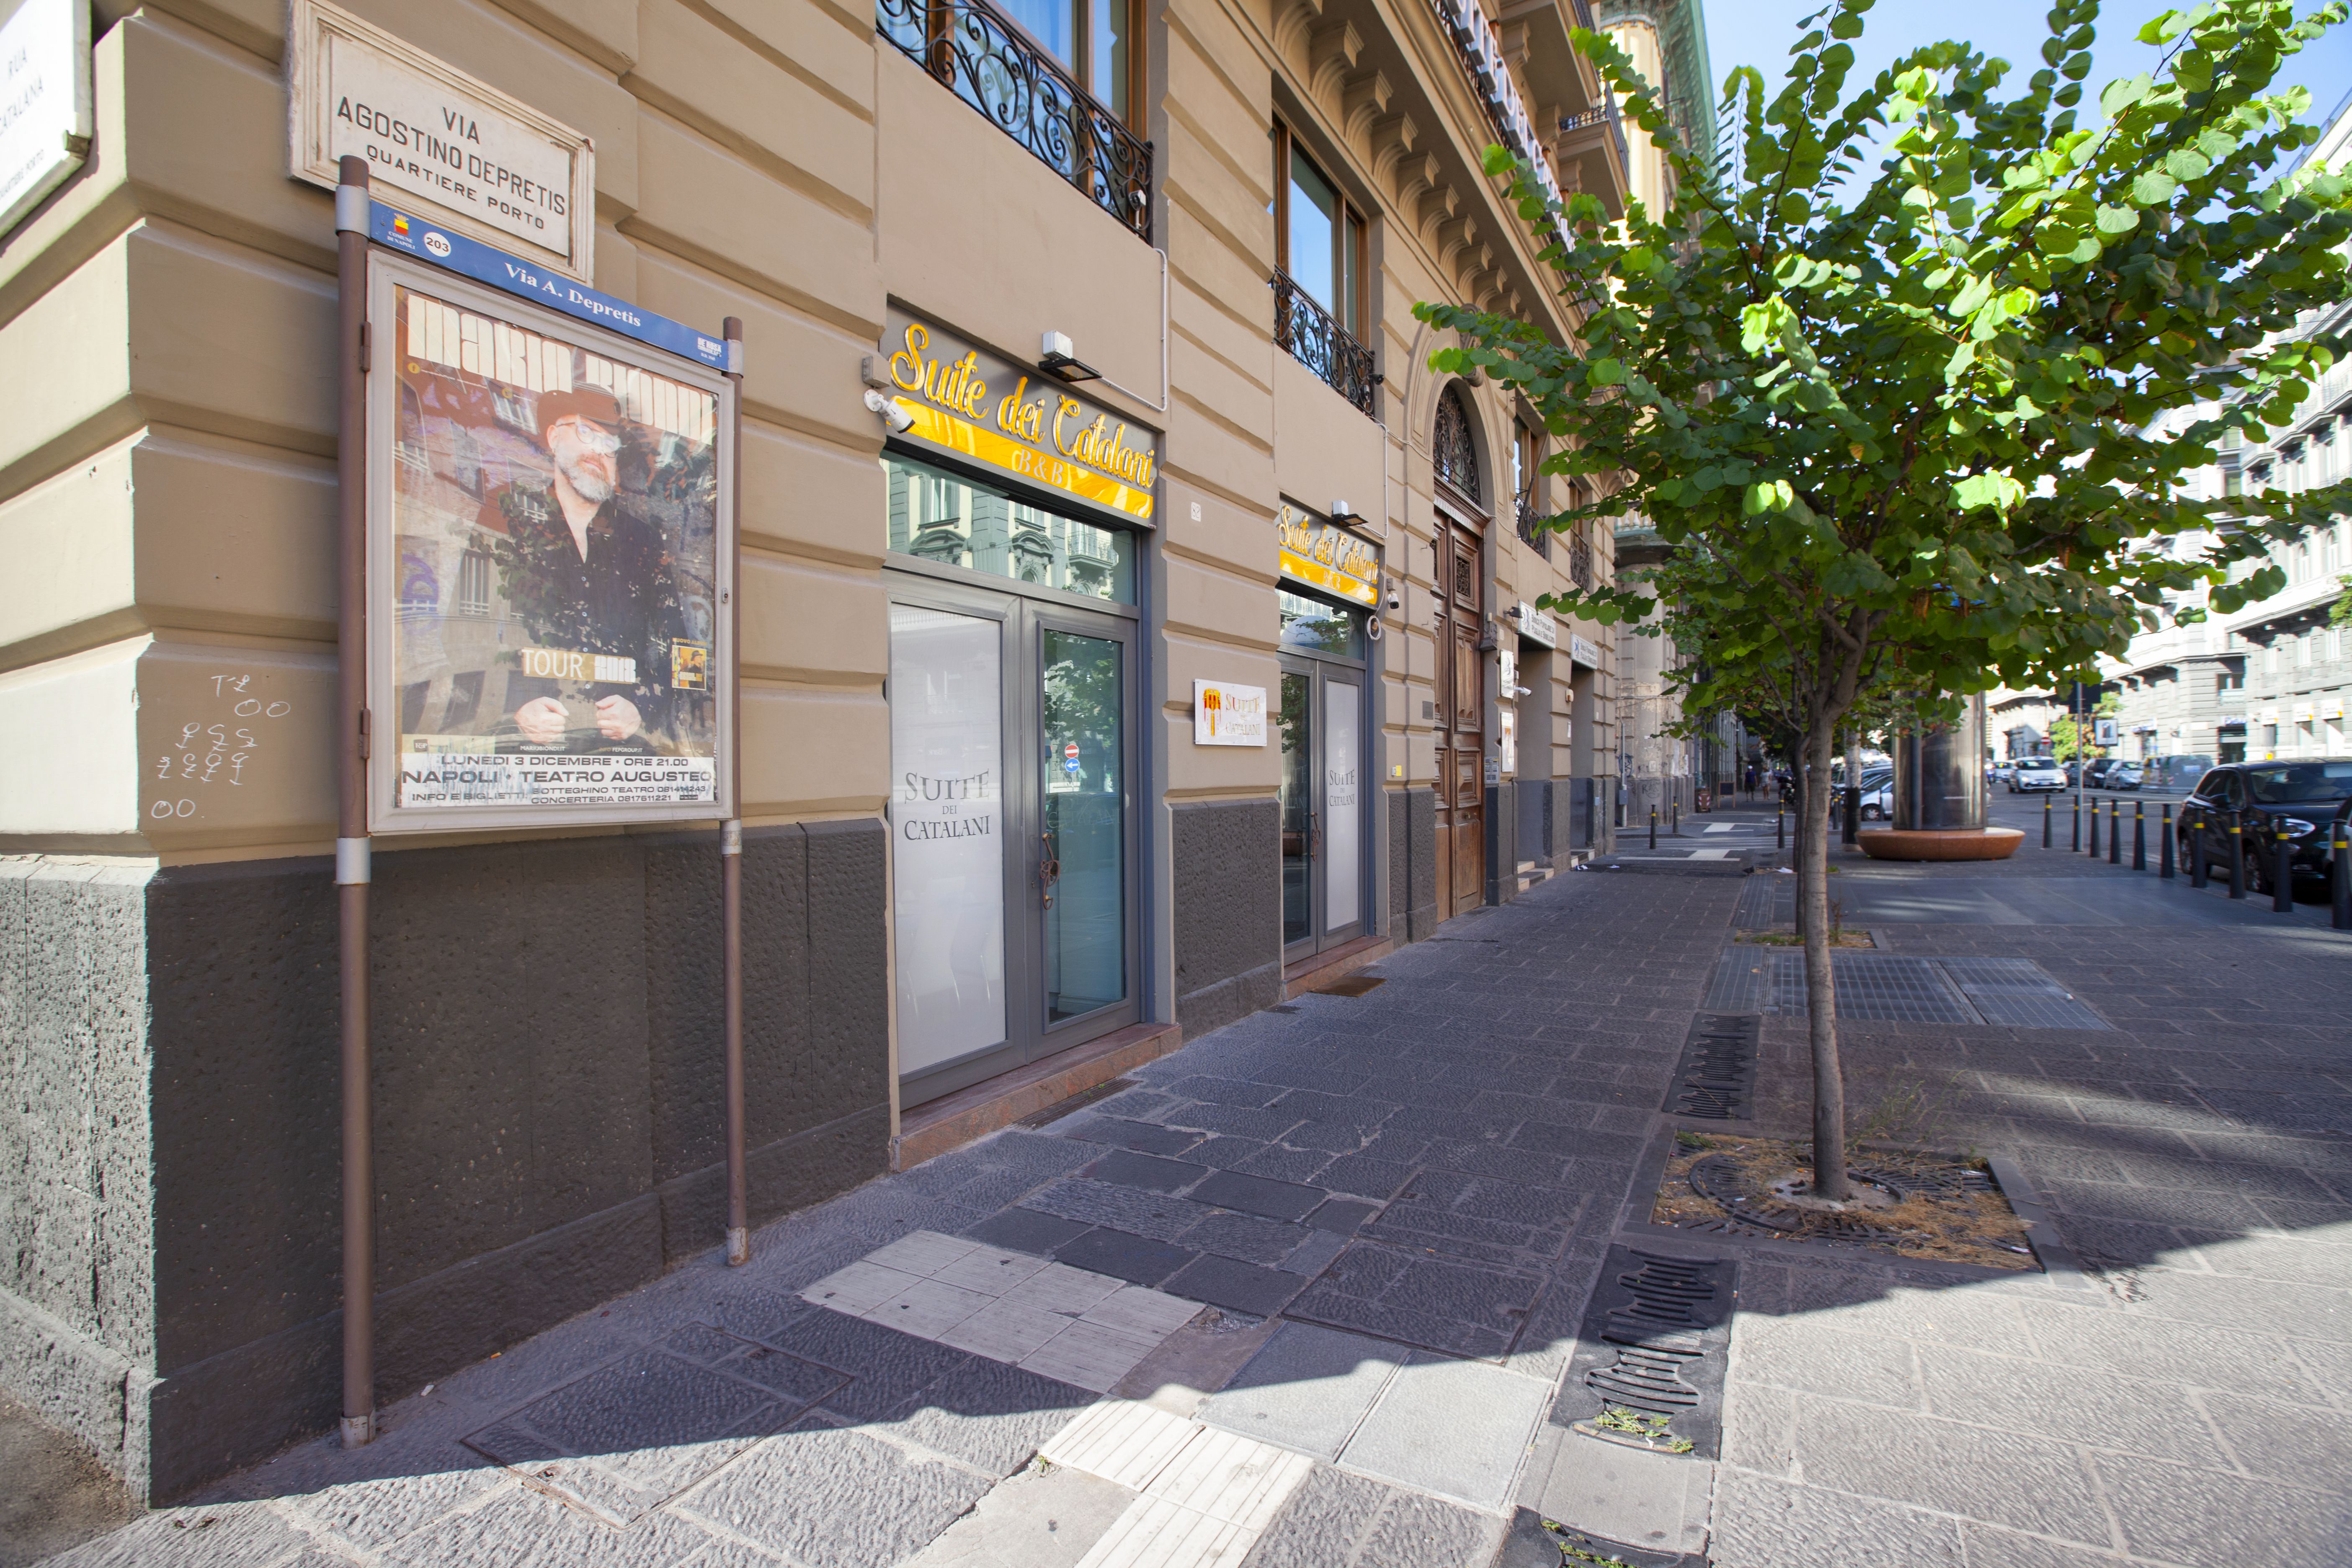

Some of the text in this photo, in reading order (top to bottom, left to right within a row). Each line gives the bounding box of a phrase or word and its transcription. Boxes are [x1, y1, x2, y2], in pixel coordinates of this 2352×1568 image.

[443, 106, 480, 144] VIA
[337, 96, 565, 216] AGOSTINO DEPRETIS
[367, 144, 544, 230] QUARTIERE PORTO
[388, 231, 413, 244] COMUNE
[395, 238, 416, 250] NAPOLI
[426, 237, 449, 252] 203
[505, 262, 641, 327] Via A. Depretis
[889, 324, 1155, 489] Suite dei Catalani
[1017, 449, 1032, 472] B
[1051, 462, 1064, 485] B
[1192, 504, 1200, 518] 82
[1278, 505, 1379, 585] Suite dei Catalani
[521, 649, 636, 683] TOUR 2018
[1226, 694, 1260, 713] SUITE
[1226, 722, 1261, 735] CATALANI
[441, 756, 509, 766] LUNEDI
[515, 757, 524, 766] 3
[530, 757, 611, 766] DICEMBRE
[402, 771, 712, 783] NAPOLI TEATRO AUGUSTEO
[905, 769, 989, 804] SUITE
[1329, 769, 1355, 787] SUITE
[942, 805, 957, 815] DEI
[1329, 794, 1355, 807] CATALANI
[905, 815, 990, 841] CATALANI
